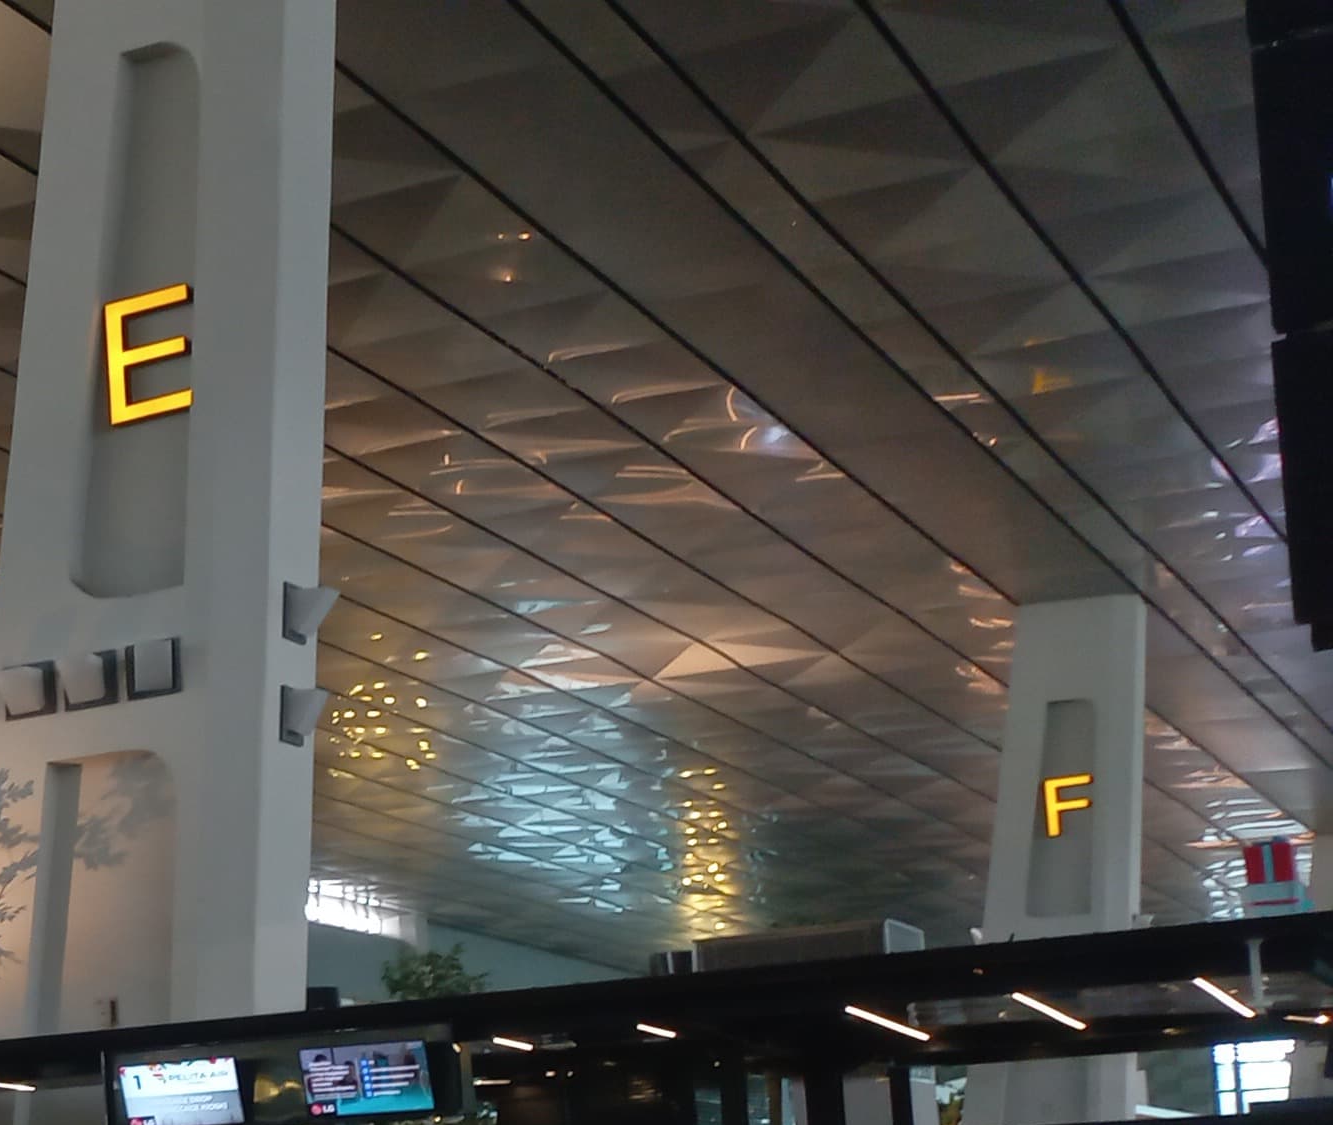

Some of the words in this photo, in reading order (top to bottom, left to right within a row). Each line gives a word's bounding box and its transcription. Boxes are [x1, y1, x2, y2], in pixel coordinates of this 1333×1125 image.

[104, 282, 193, 425] E
[1043, 773, 1093, 838] F
[133, 1075, 141, 1090] 1
[169, 1072, 206, 1081] PELITA
[323, 1104, 335, 1113] LG
